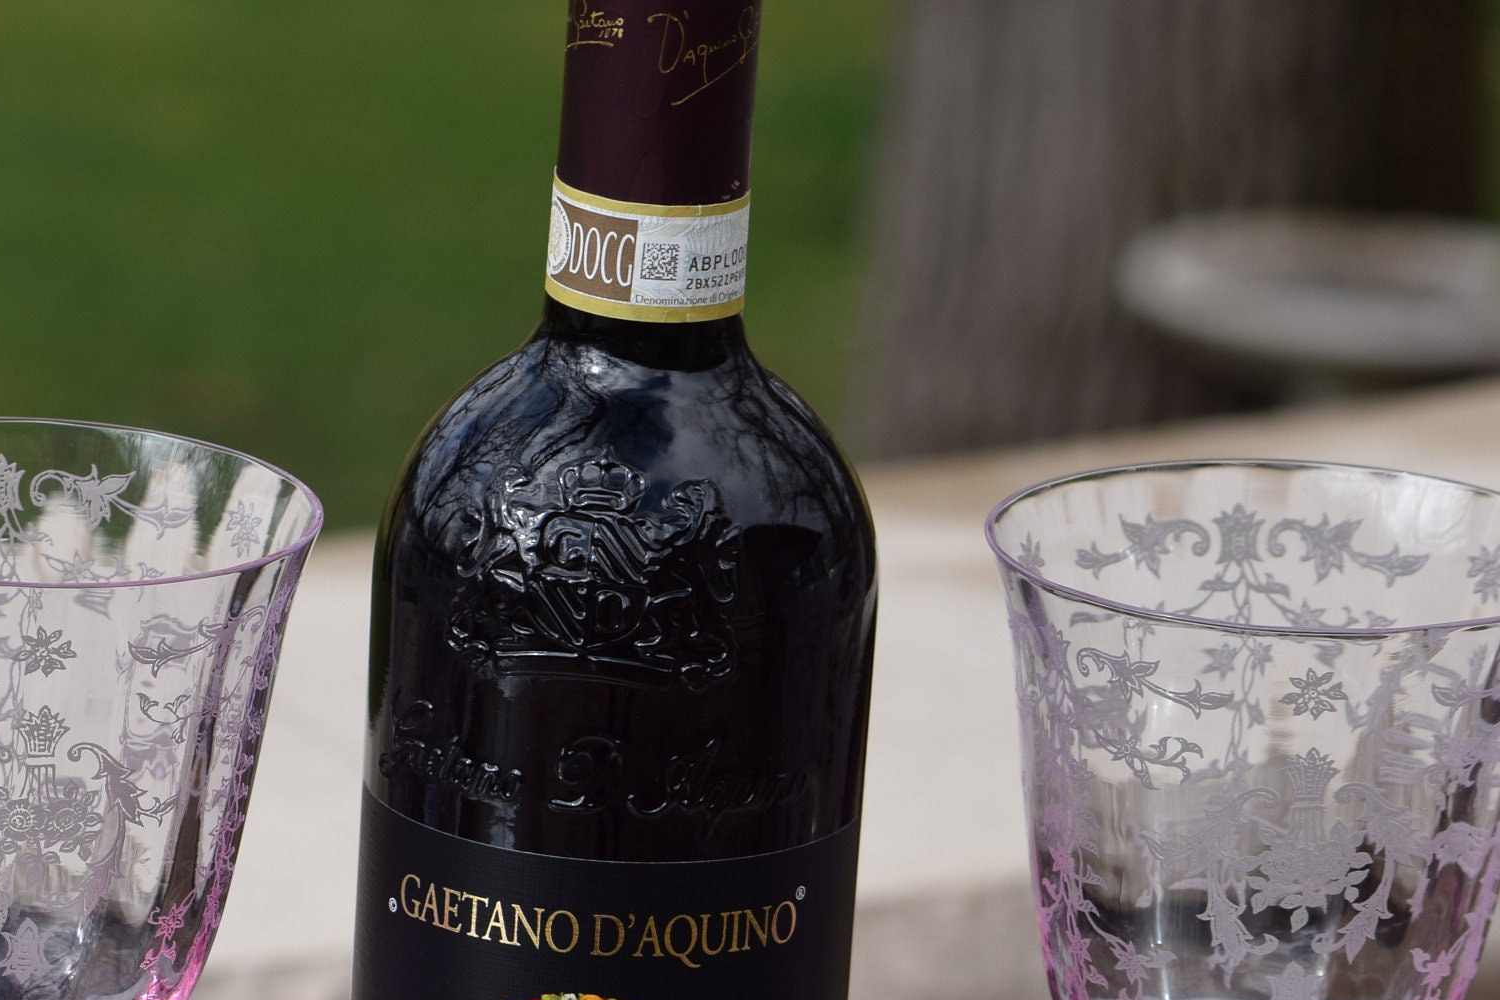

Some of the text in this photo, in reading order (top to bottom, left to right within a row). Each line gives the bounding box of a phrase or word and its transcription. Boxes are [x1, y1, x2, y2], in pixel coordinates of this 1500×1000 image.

[569, 222, 636, 287] DOCG
[635, 294, 707, 305] Denominazione
[401, 873, 797, 968] GAETANO D'AQUINO
